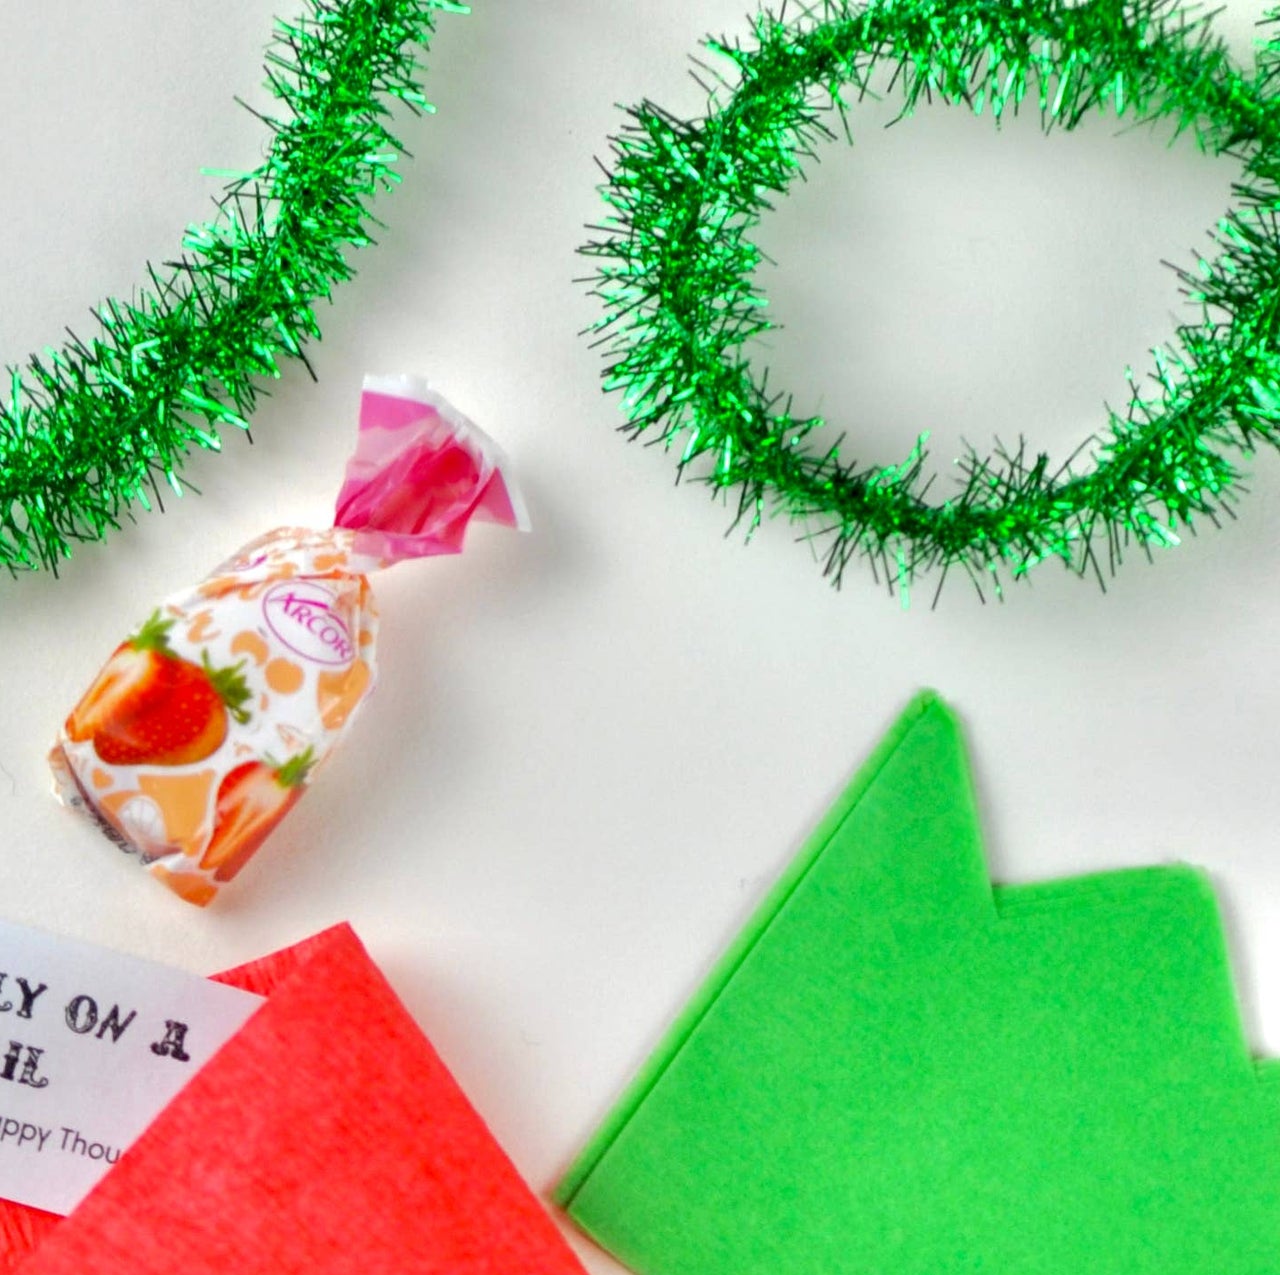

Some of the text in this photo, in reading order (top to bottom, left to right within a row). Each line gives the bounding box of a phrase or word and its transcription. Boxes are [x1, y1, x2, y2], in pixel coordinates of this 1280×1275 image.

[279, 592, 351, 658] ARCOR
[64, 995, 138, 1044] ON
[149, 1018, 191, 1063] A
[60, 1127, 121, 1165] Thou
